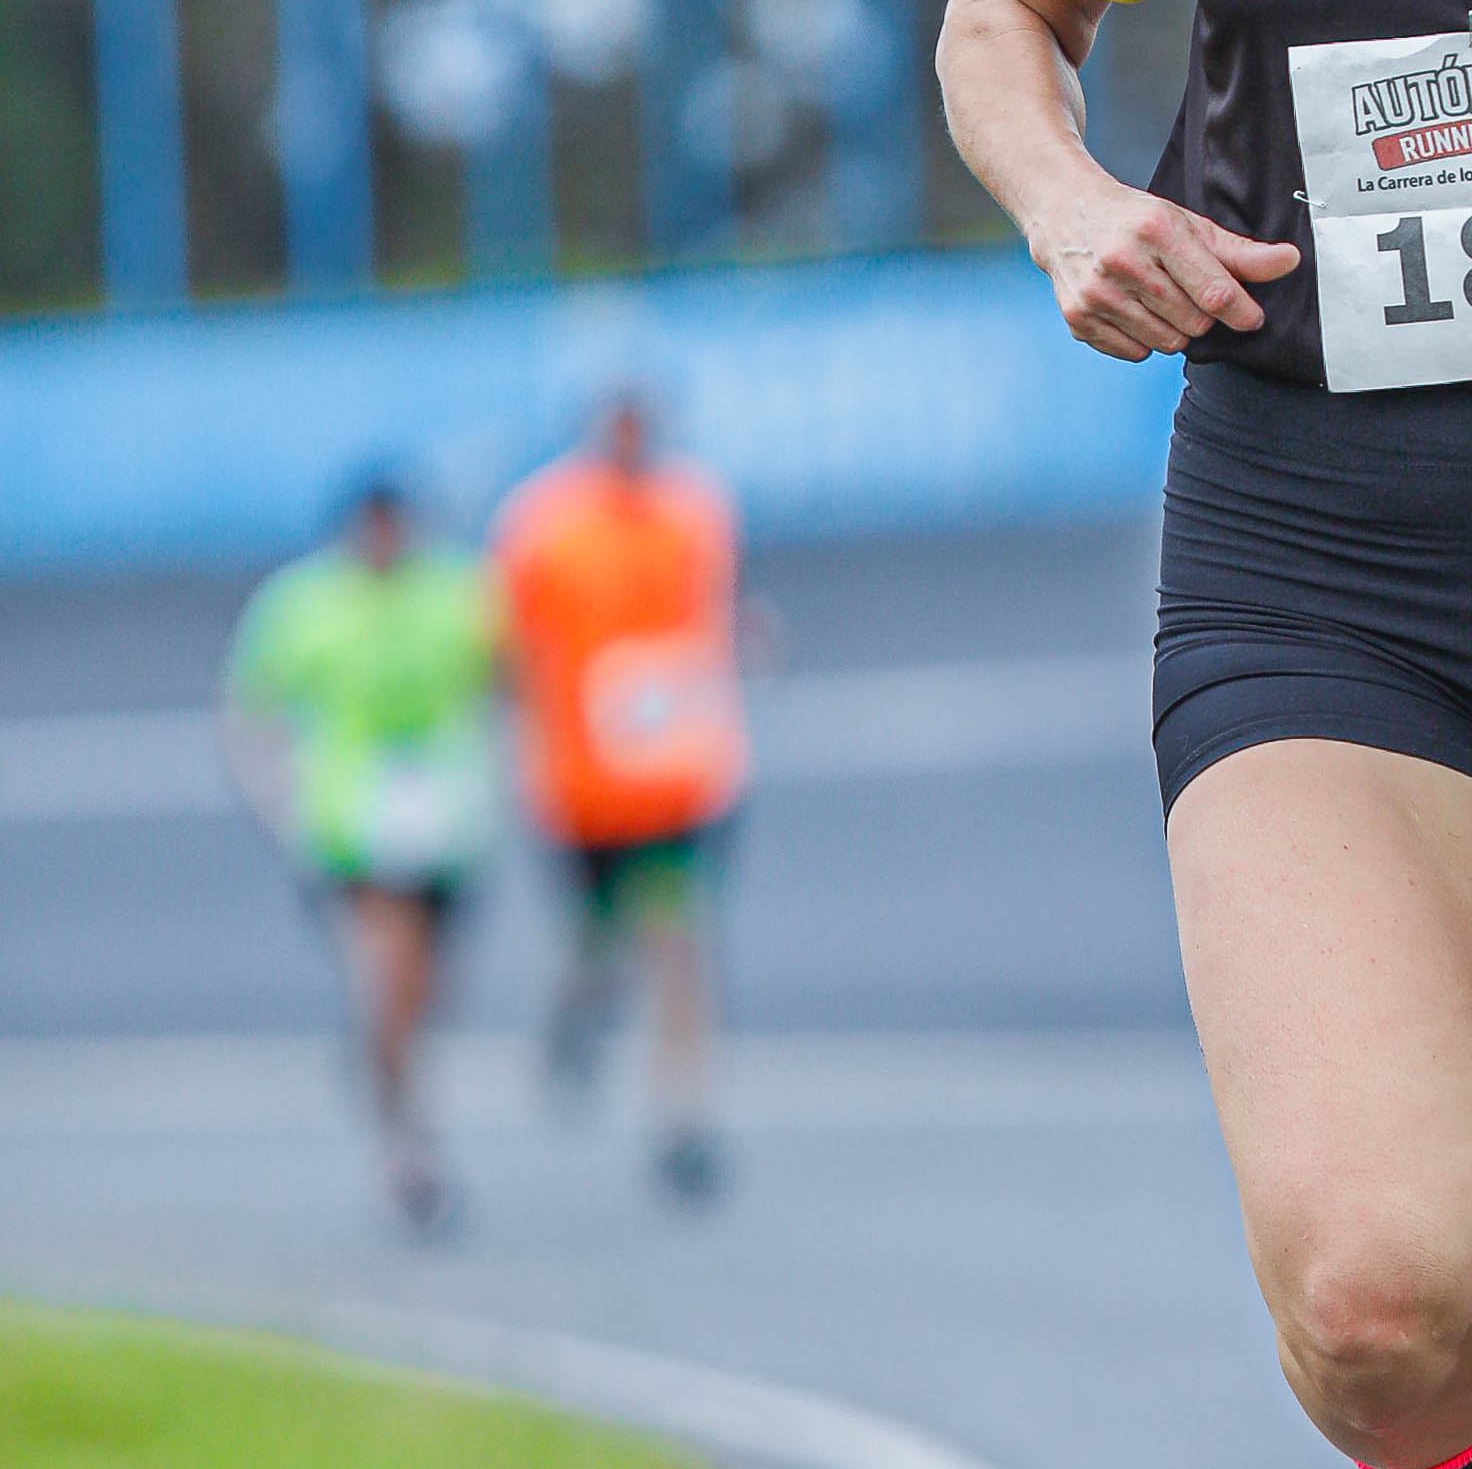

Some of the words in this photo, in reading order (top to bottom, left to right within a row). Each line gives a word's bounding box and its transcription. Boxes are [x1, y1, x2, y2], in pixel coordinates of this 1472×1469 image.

[1357, 178, 1375, 193] La
[1378, 174, 1433, 191] Carrera
[1437, 170, 1456, 185] de
